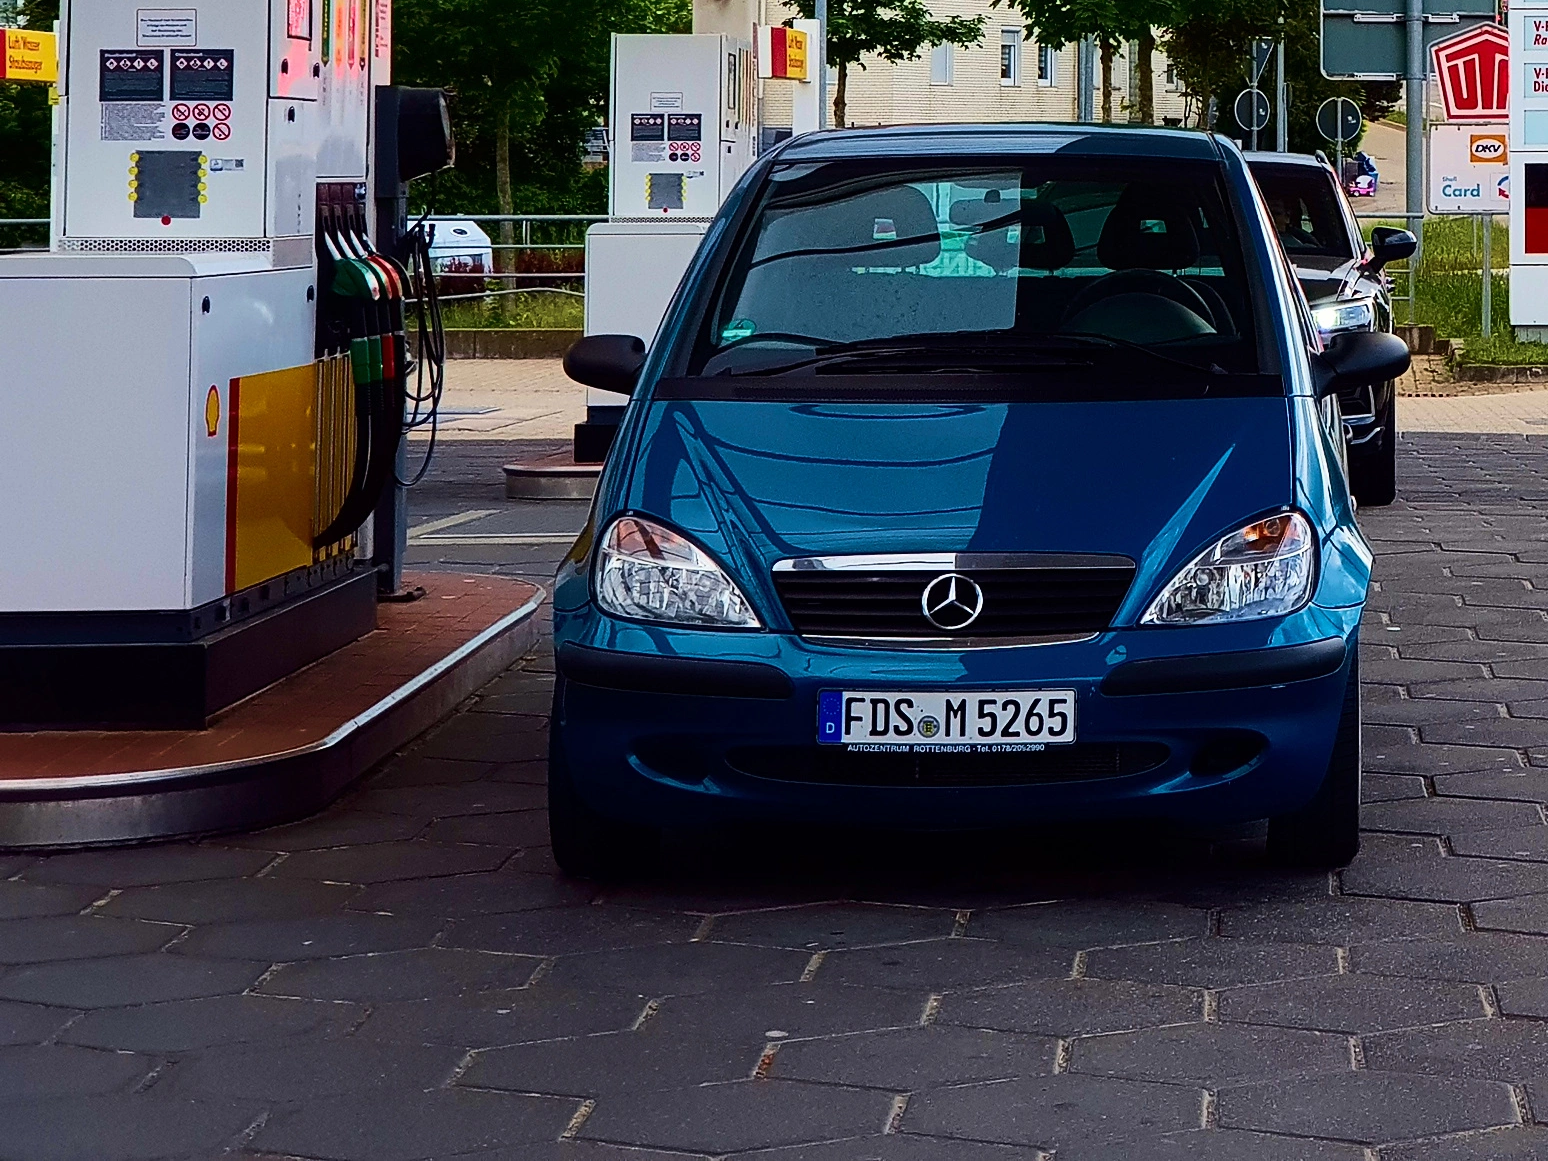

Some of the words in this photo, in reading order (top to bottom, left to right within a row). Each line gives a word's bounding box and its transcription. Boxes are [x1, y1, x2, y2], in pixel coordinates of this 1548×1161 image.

[1474, 143, 1502, 153] DKV
[1442, 183, 1480, 197] Card
[844, 697, 914, 737] FDS
[945, 698, 967, 737] M
[977, 697, 1068, 737] 5265
[826, 722, 835, 734] D
[847, 744, 910, 752] AUTOZENTRUM
[913, 744, 971, 753] ROTTENBURG
